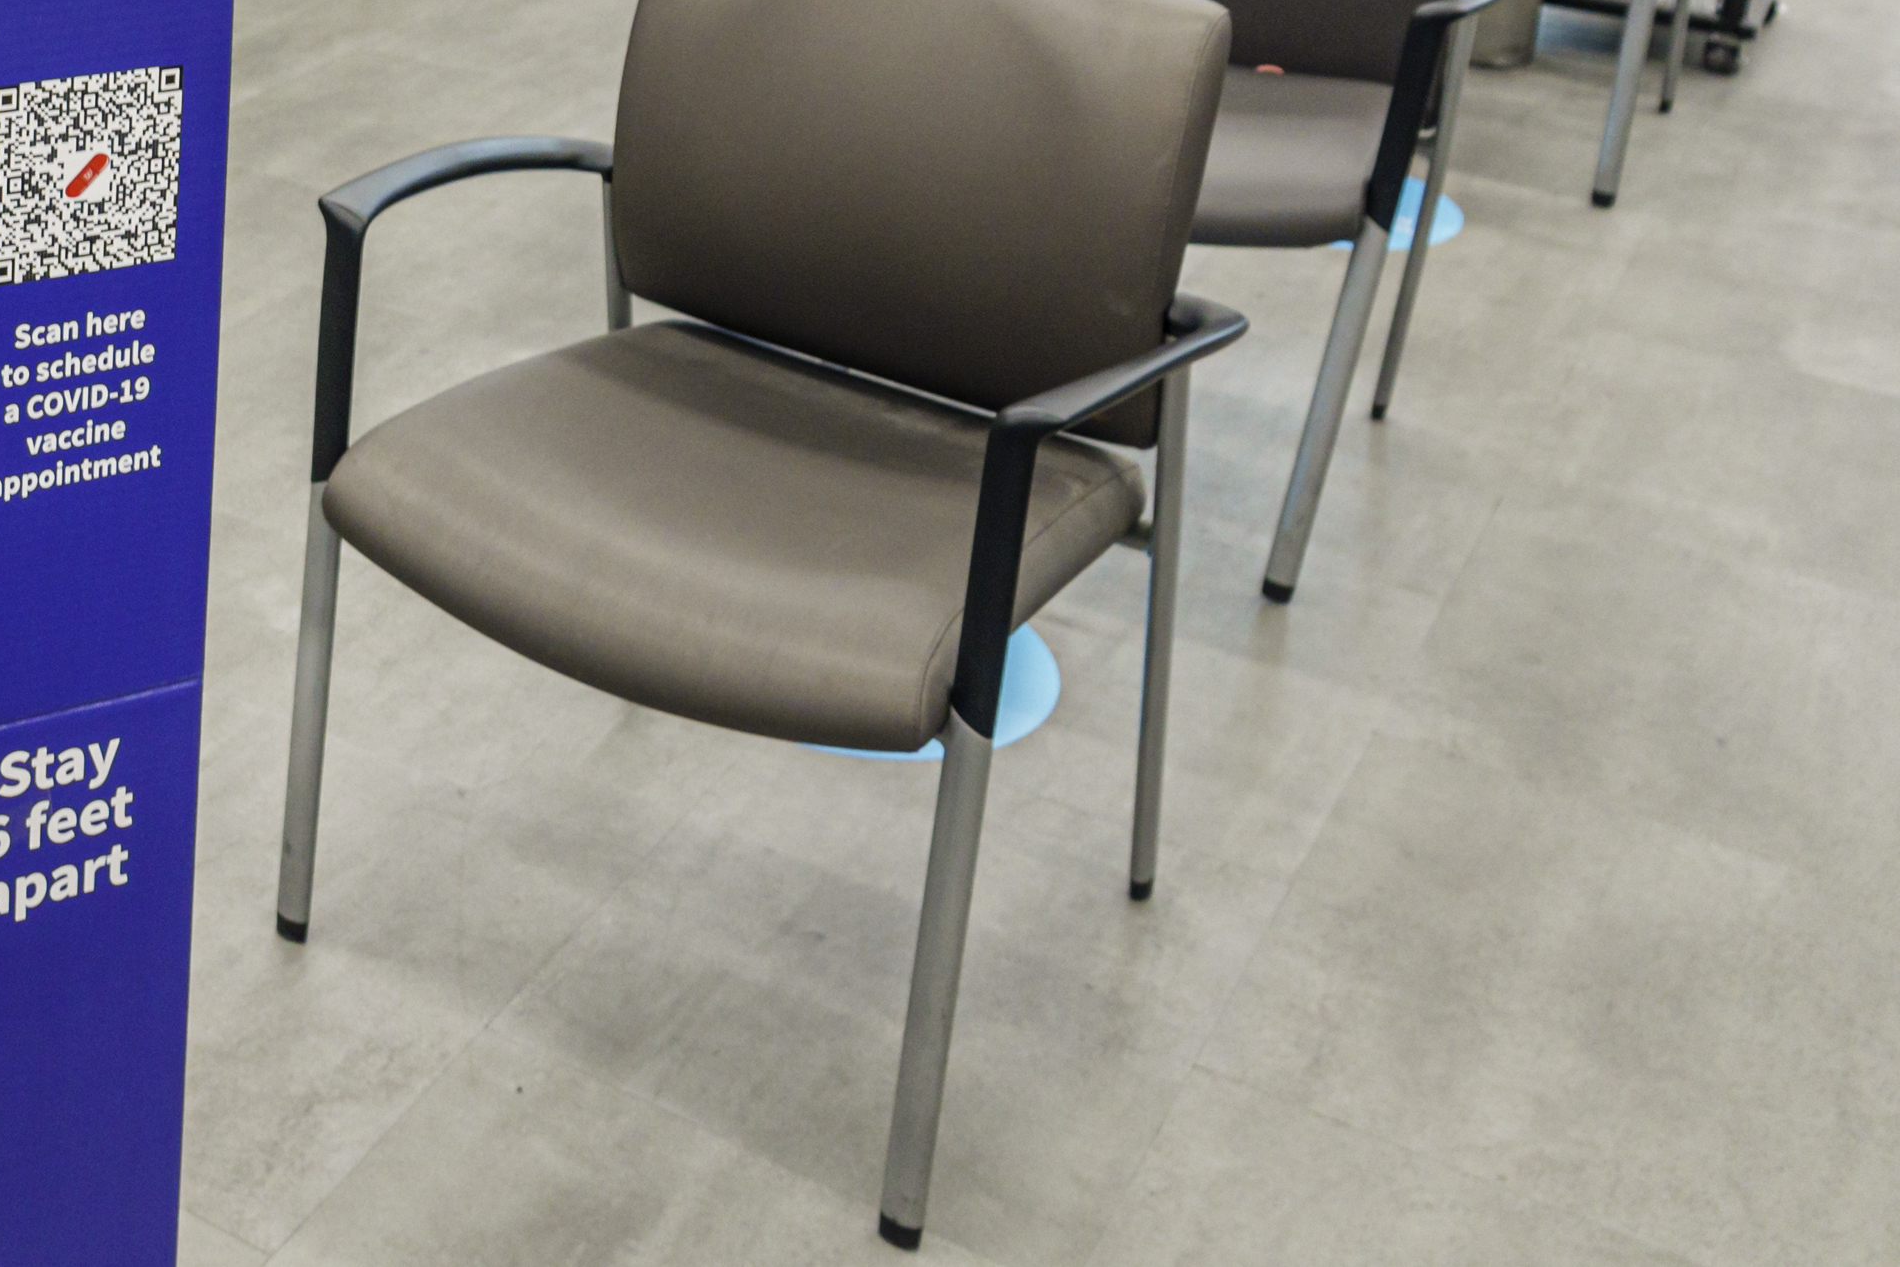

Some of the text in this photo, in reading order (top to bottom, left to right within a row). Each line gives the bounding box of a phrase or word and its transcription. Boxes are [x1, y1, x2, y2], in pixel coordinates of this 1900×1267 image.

[14, 309, 146, 349] Scan here
[1, 340, 155, 388] to schedule
[4, 376, 150, 424] a COVID-19
[26, 418, 126, 456] vaccine
[25, 786, 134, 851] feet
